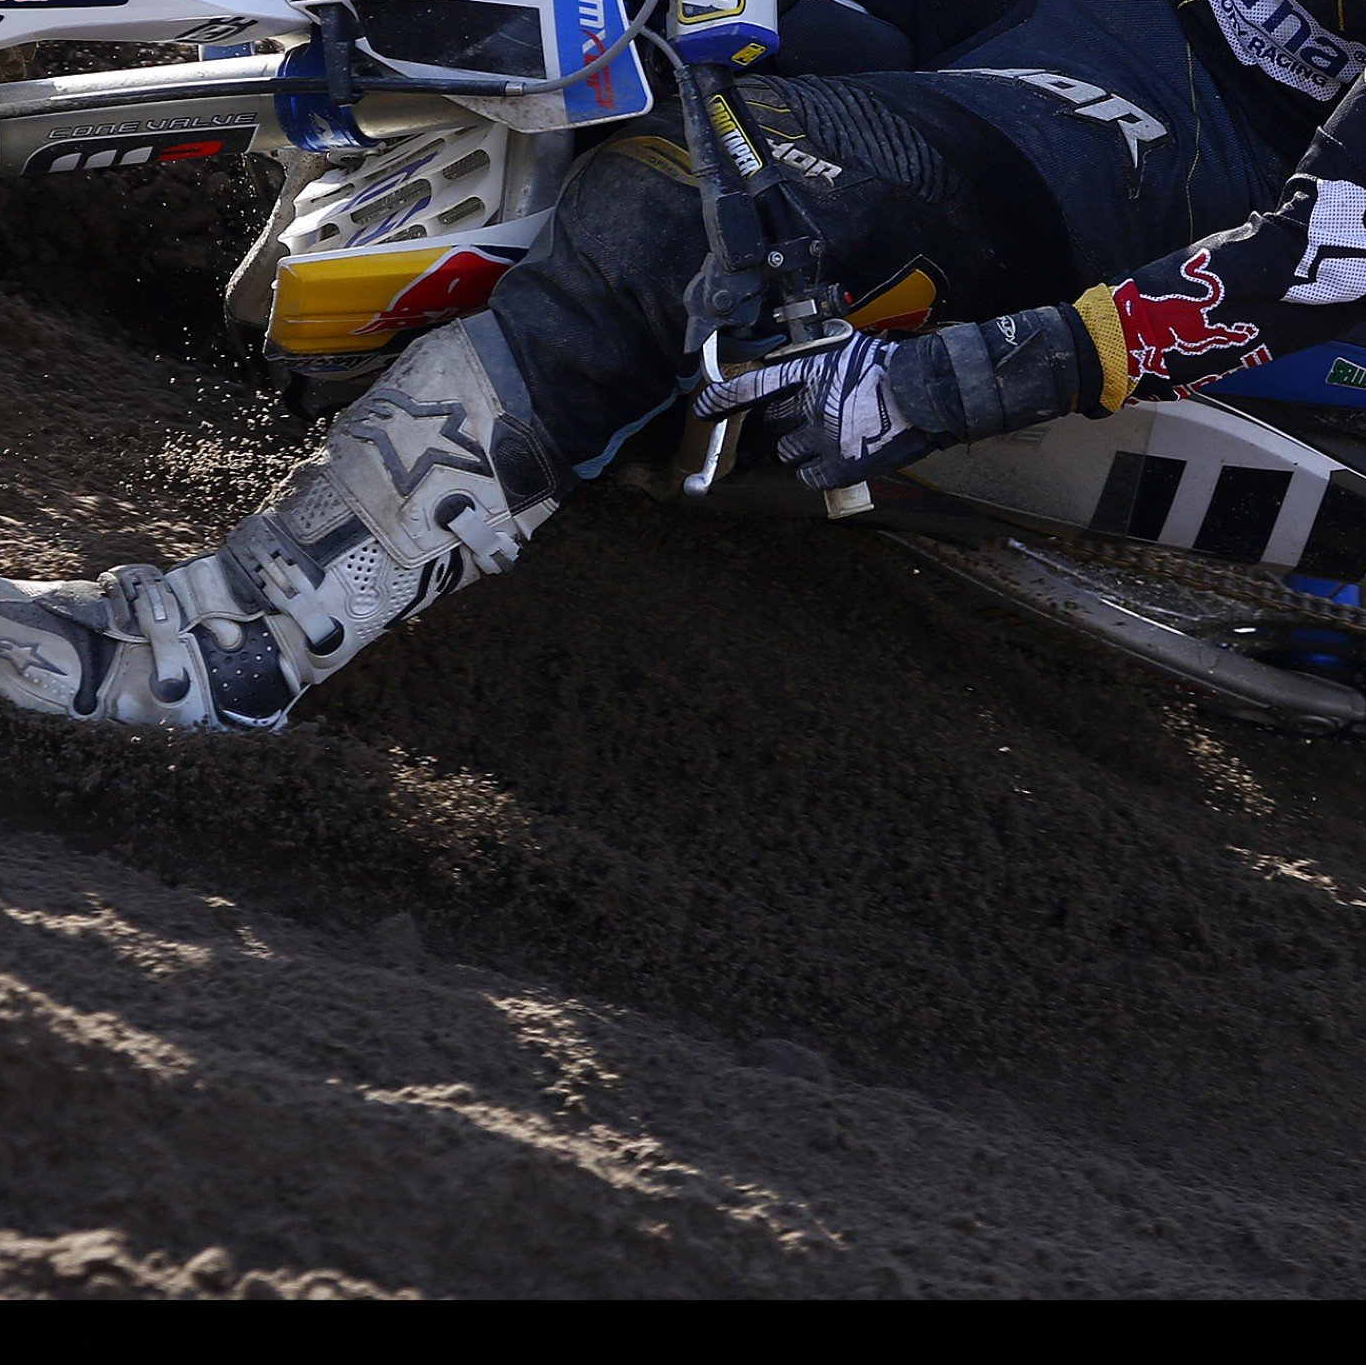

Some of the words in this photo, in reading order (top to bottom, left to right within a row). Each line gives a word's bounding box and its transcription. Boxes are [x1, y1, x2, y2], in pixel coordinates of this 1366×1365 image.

[1247, 35, 1328, 87] RACING
[48, 120, 139, 140] CONE
[146, 112, 257, 131] VALVE
